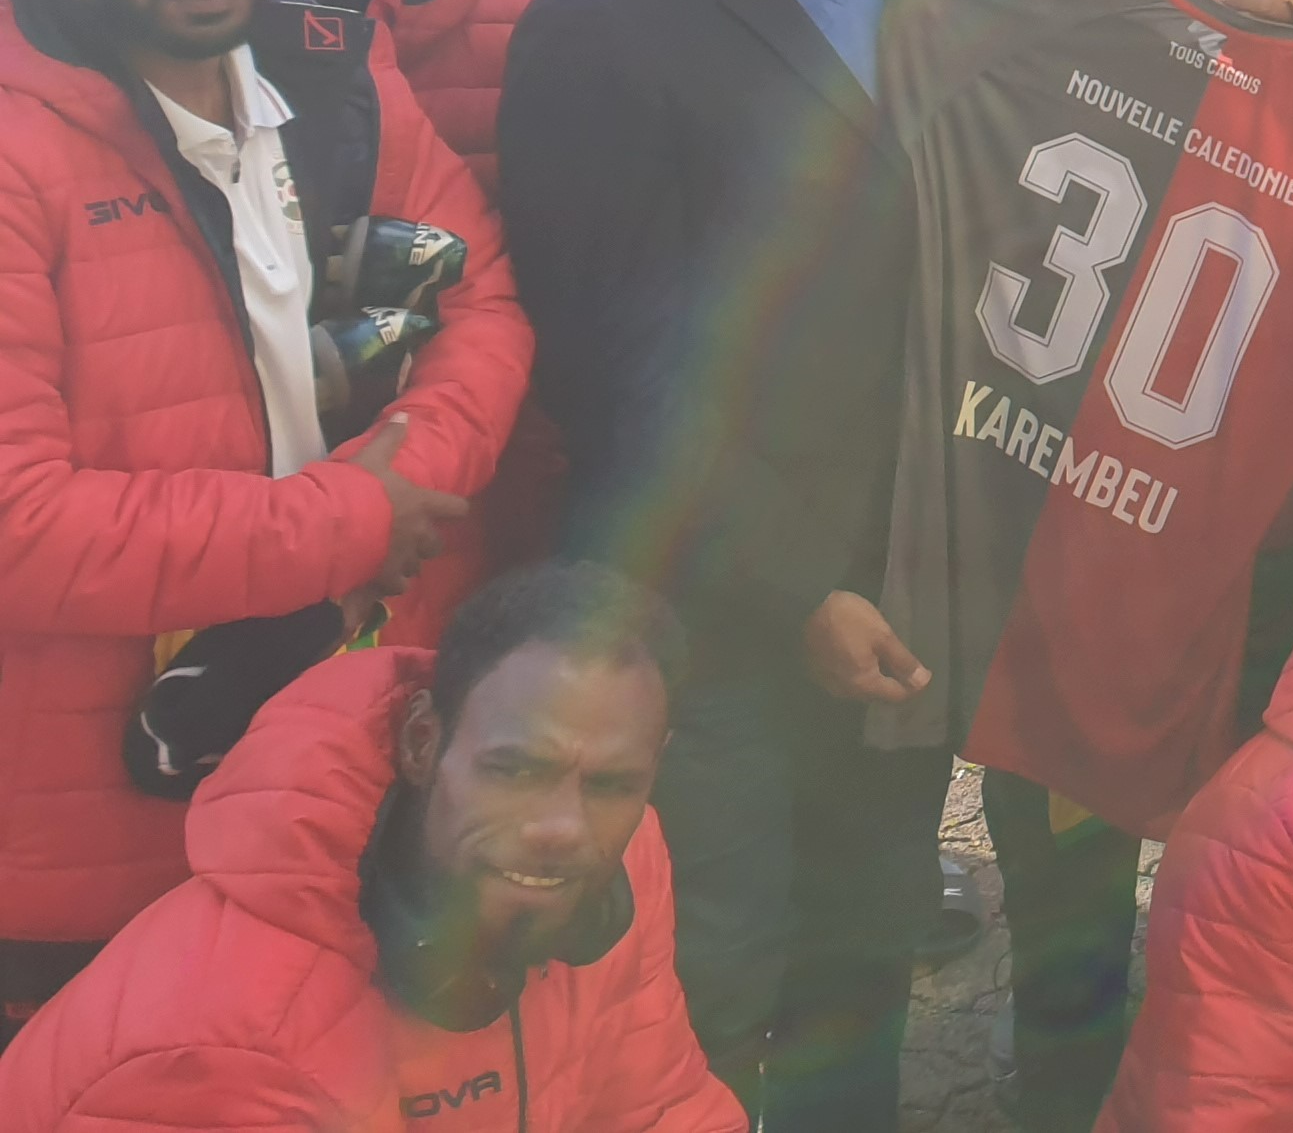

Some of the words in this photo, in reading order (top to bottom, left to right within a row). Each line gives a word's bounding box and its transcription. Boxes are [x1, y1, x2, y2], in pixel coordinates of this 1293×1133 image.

[1066, 69, 1184, 146] NOUVELLE
[1169, 40, 1205, 69] TOUS
[1206, 58, 1262, 95] CAGOUS
[975, 131, 1280, 450] 30
[953, 380, 1178, 534] KAREMBEU
